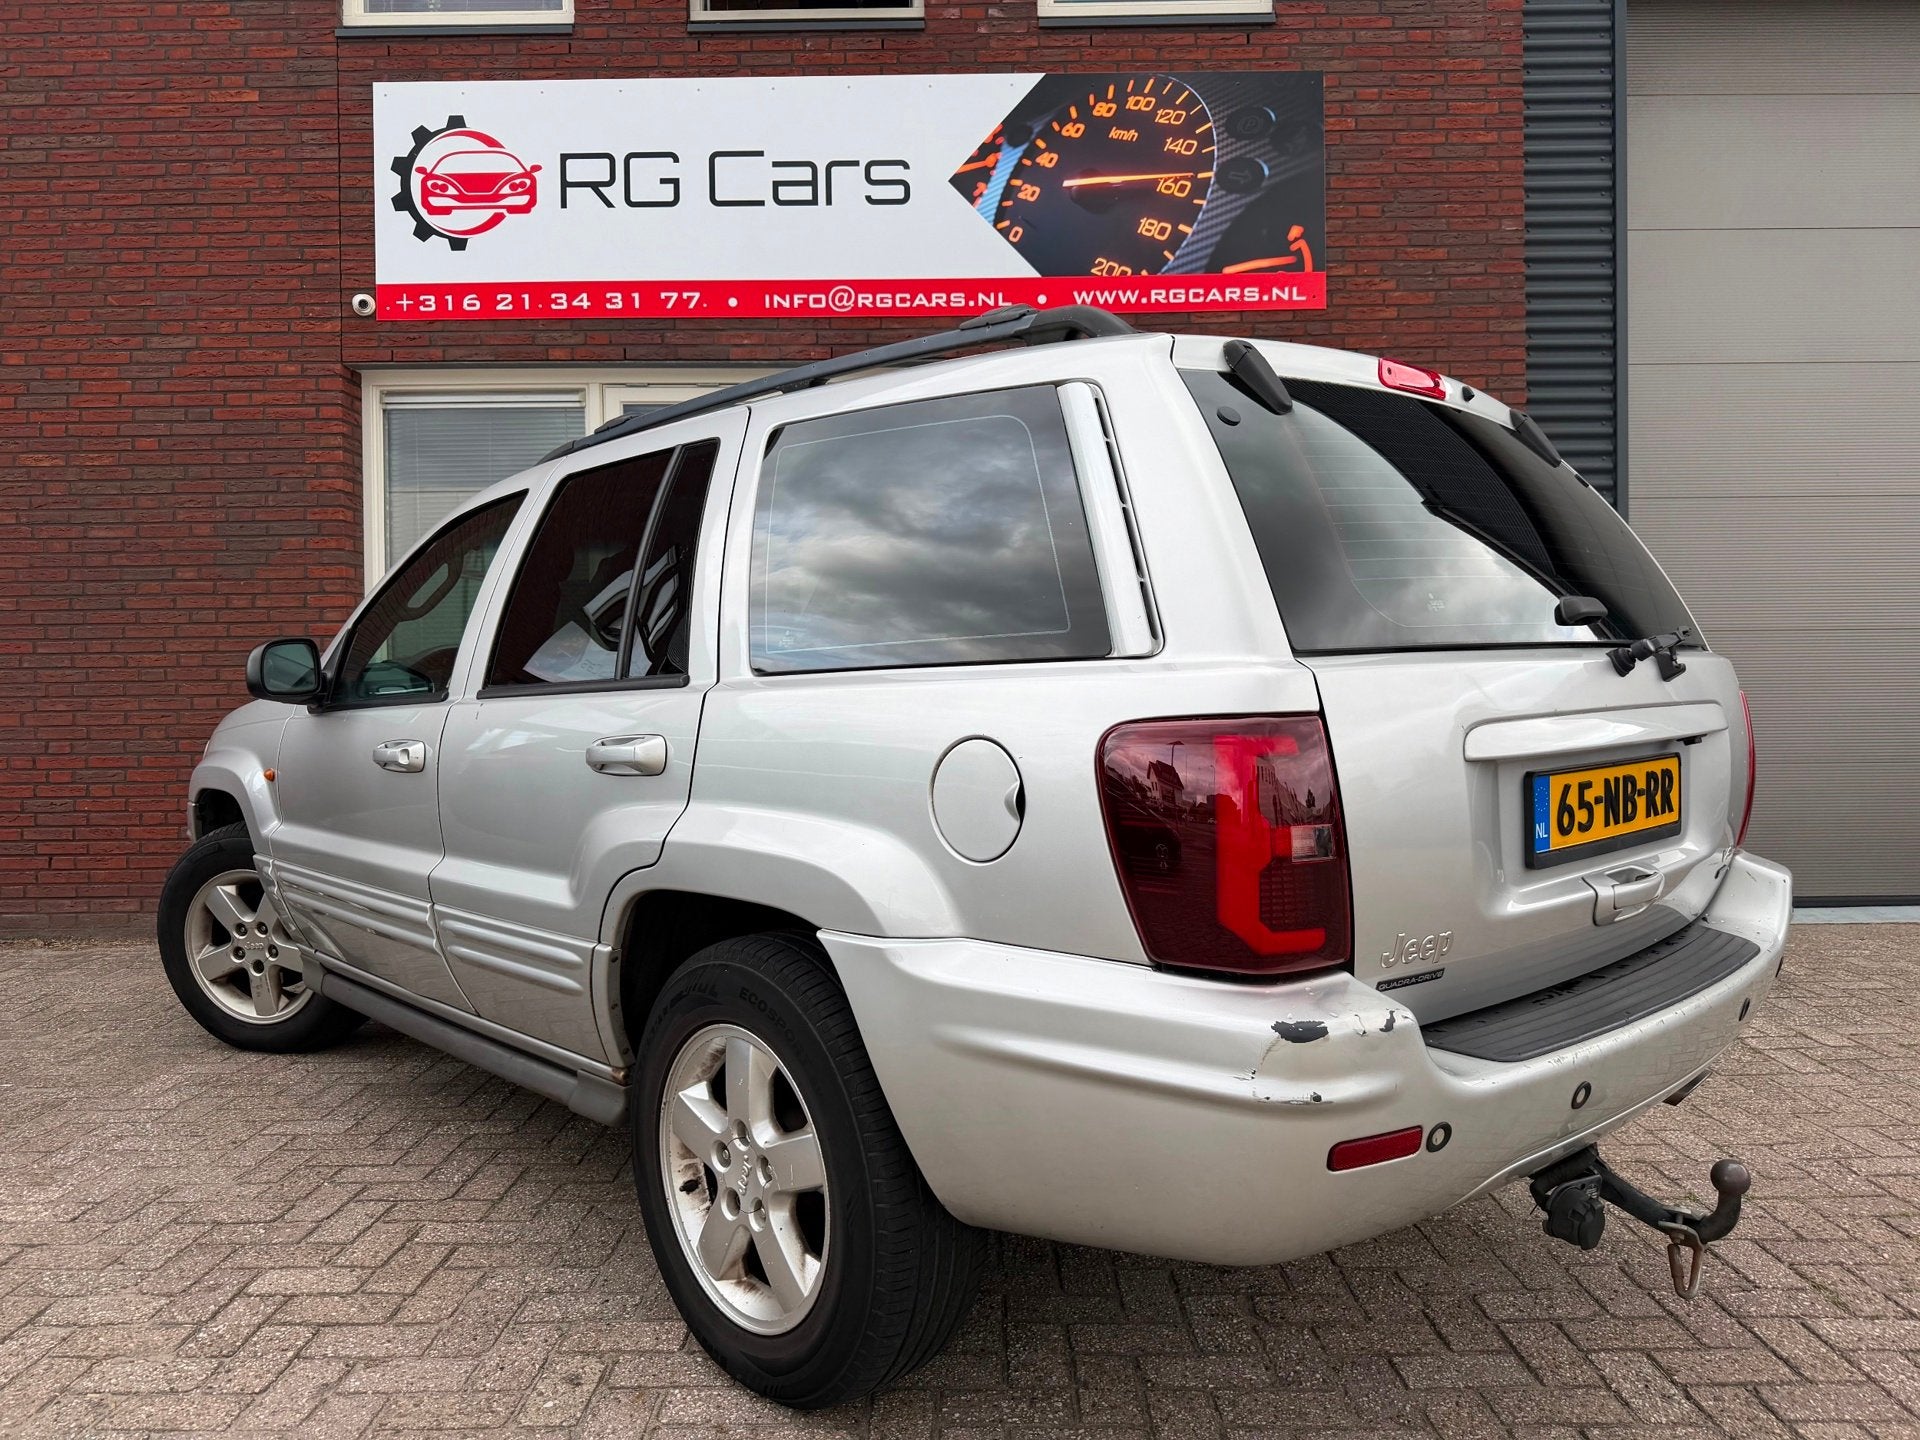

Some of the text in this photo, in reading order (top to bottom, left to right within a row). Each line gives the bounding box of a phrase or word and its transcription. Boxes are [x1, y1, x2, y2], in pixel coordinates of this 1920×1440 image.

[1093, 102, 1117, 117] 80
[1125, 96, 1156, 111] 100
[1155, 109, 1186, 125] 120
[1061, 122, 1085, 138] 60
[1108, 127, 1139, 142] km/h
[1163, 137, 1198, 155] 140
[1035, 152, 1059, 168] 40
[559, 150, 911, 209] RG Cars
[1156, 177, 1192, 198] 160
[1017, 184, 1041, 202] 20
[1008, 226, 1024, 243] 0
[1137, 217, 1172, 241] 180
[396, 293, 481, 312] +316
[551, 292, 591, 310] 34
[605, 292, 640, 309] 31
[765, 285, 1012, 312] INFO@RGCARS.NL
[1073, 286, 1307, 305] WWW.RGCARS.NL
[1557, 768, 1674, 837] 65-NB-RR
[1535, 822, 1549, 839] NL
[1381, 931, 1454, 968] Jeep
[1378, 970, 1444, 991] QUADRA-DRIVE
